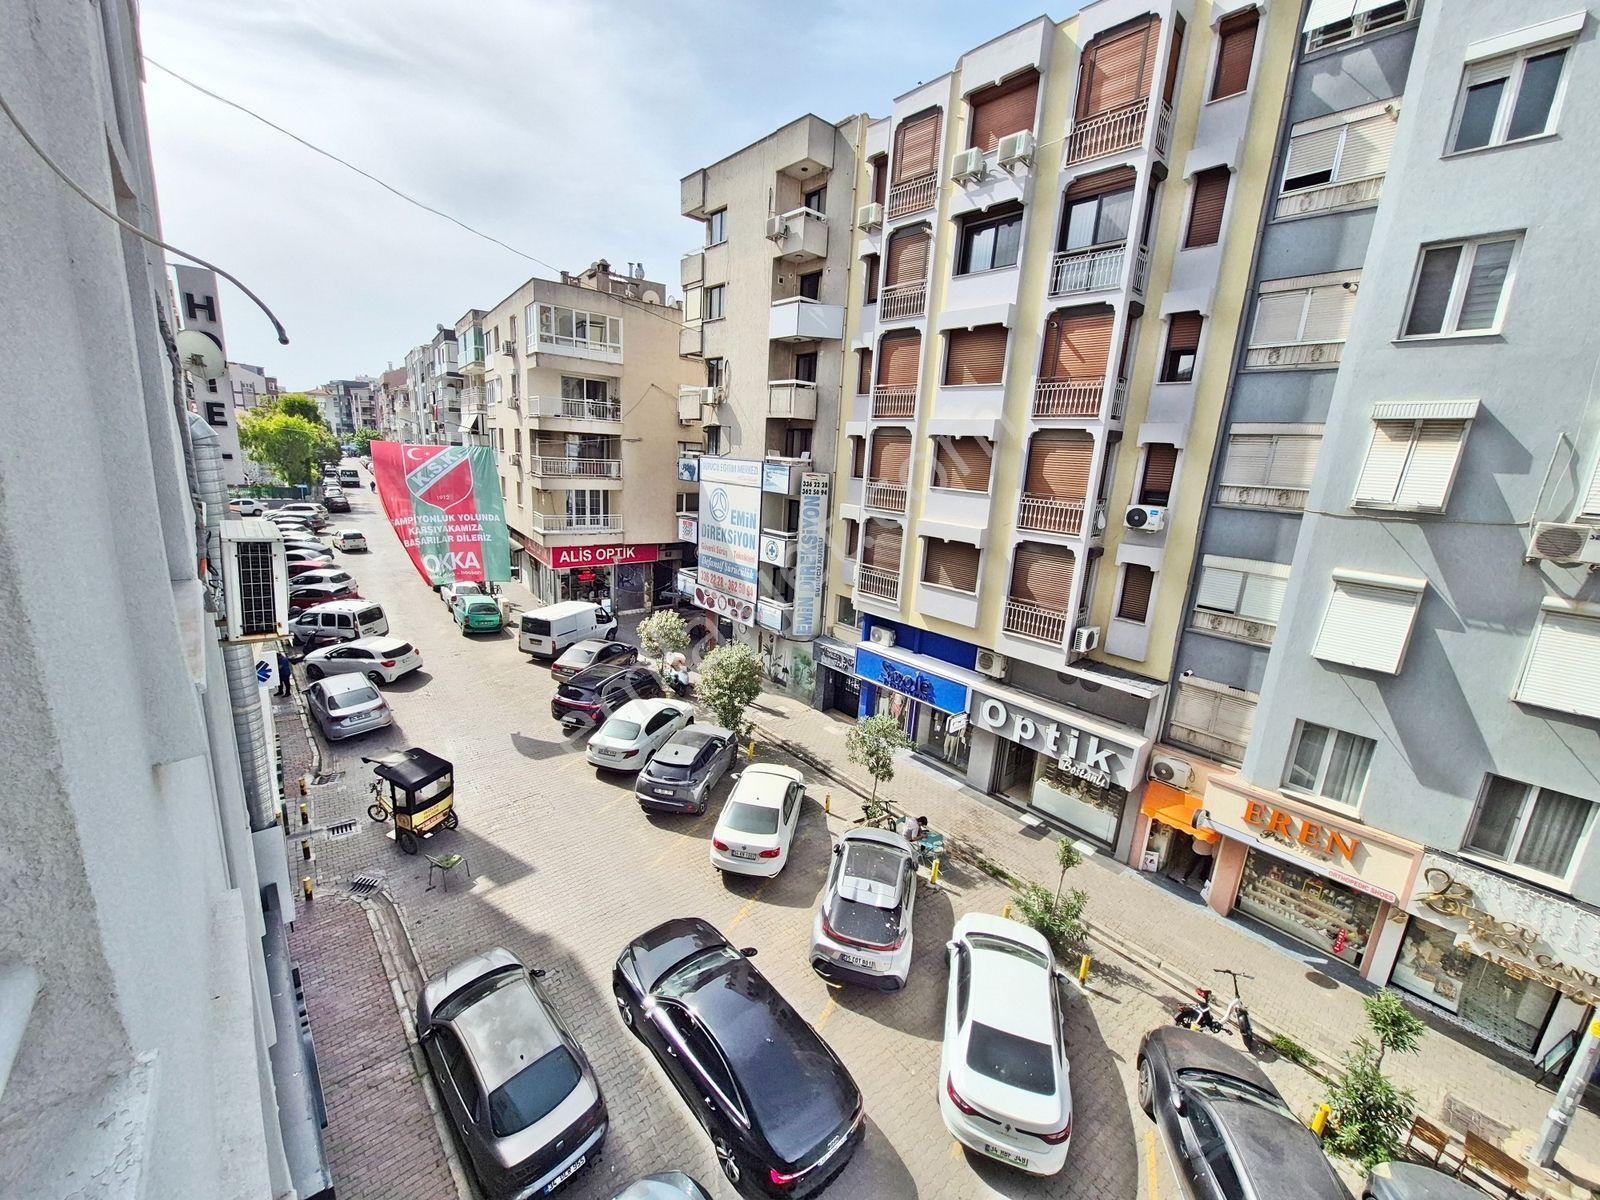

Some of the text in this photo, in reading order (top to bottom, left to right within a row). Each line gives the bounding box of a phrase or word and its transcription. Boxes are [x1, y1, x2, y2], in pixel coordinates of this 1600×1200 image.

[457, 514, 500, 522] YOLUNDA
[423, 551, 480, 573] OKKA
[980, 698, 1116, 773] Optik
[1241, 799, 1360, 861] EREN
